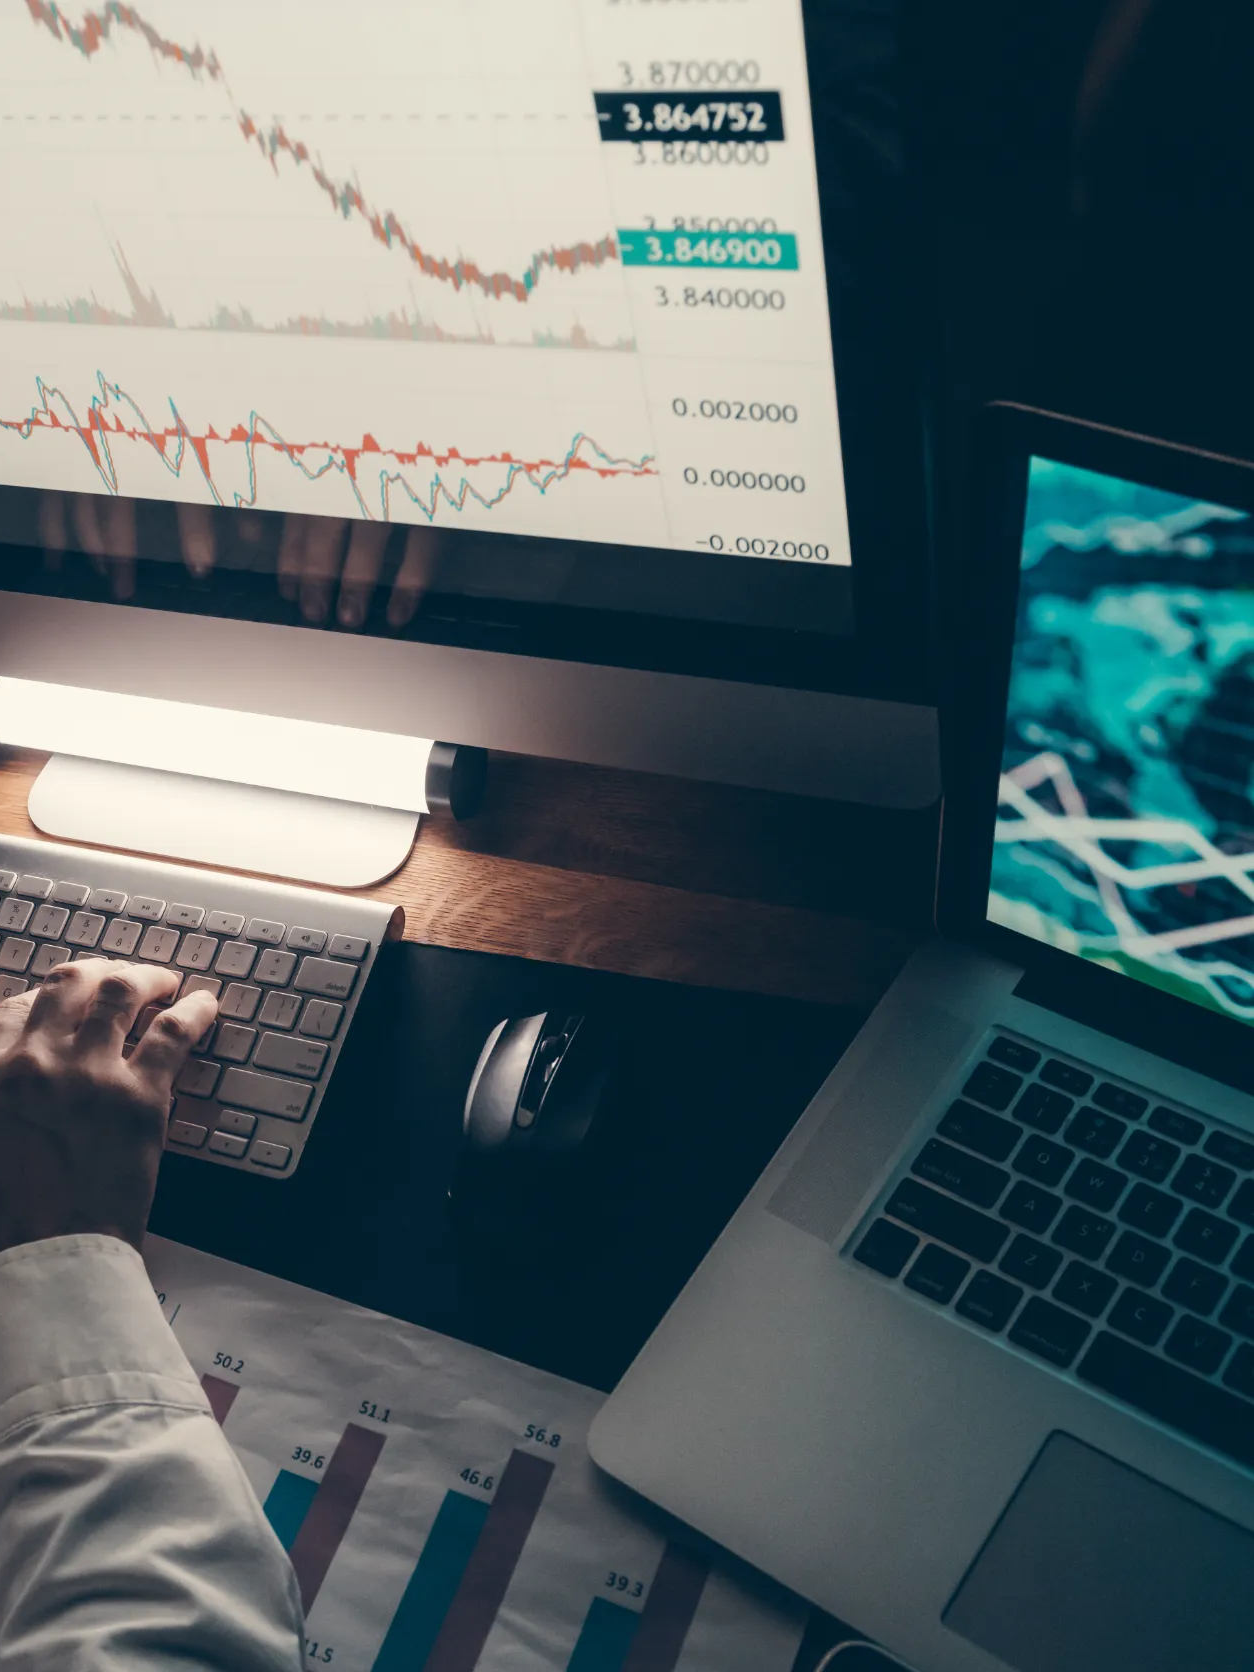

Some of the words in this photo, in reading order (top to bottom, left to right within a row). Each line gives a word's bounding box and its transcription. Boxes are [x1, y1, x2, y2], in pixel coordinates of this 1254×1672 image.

[618, 60, 761, 86] 3.870000
[622, 102, 768, 132] 3.864752
[645, 235, 782, 265] 3.846900
[654, 285, 786, 311] 3.840000
[672, 398, 798, 424] 0.002000
[684, 466, 806, 494] 0.000000
[695, 534, 830, 562] -0.002000
[7, 916, 15, 925] 5
[42, 924, 49, 933] 6
[79, 931, 87, 940] 7
[115, 937, 123, 947] 8
[154, 945, 161, 954] 9
[11, 949, 18, 959] T
[191, 953, 199, 963] 0
[49, 957, 56, 967] Y
[3, 987, 12, 998] G
[1037, 1152, 1051, 1165] Q
[1088, 1175, 1106, 1188] W
[1023, 1199, 1036, 1212] A
[1078, 1224, 1089, 1237] S
[1023, 1251, 1038, 1267] Z
[1132, 1249, 1146, 1263] D
[1077, 1280, 1093, 1294] X
[1134, 1306, 1147, 1321] C
[212, 1351, 245, 1374] 50.2
[358, 1400, 391, 1423] 51.1
[524, 1424, 561, 1448] 56.8
[291, 1446, 326, 1469] 39.6
[459, 1467, 494, 1491] 46.6
[605, 1571, 644, 1598] 39.3
[305, 1639, 334, 1664] 1.5
